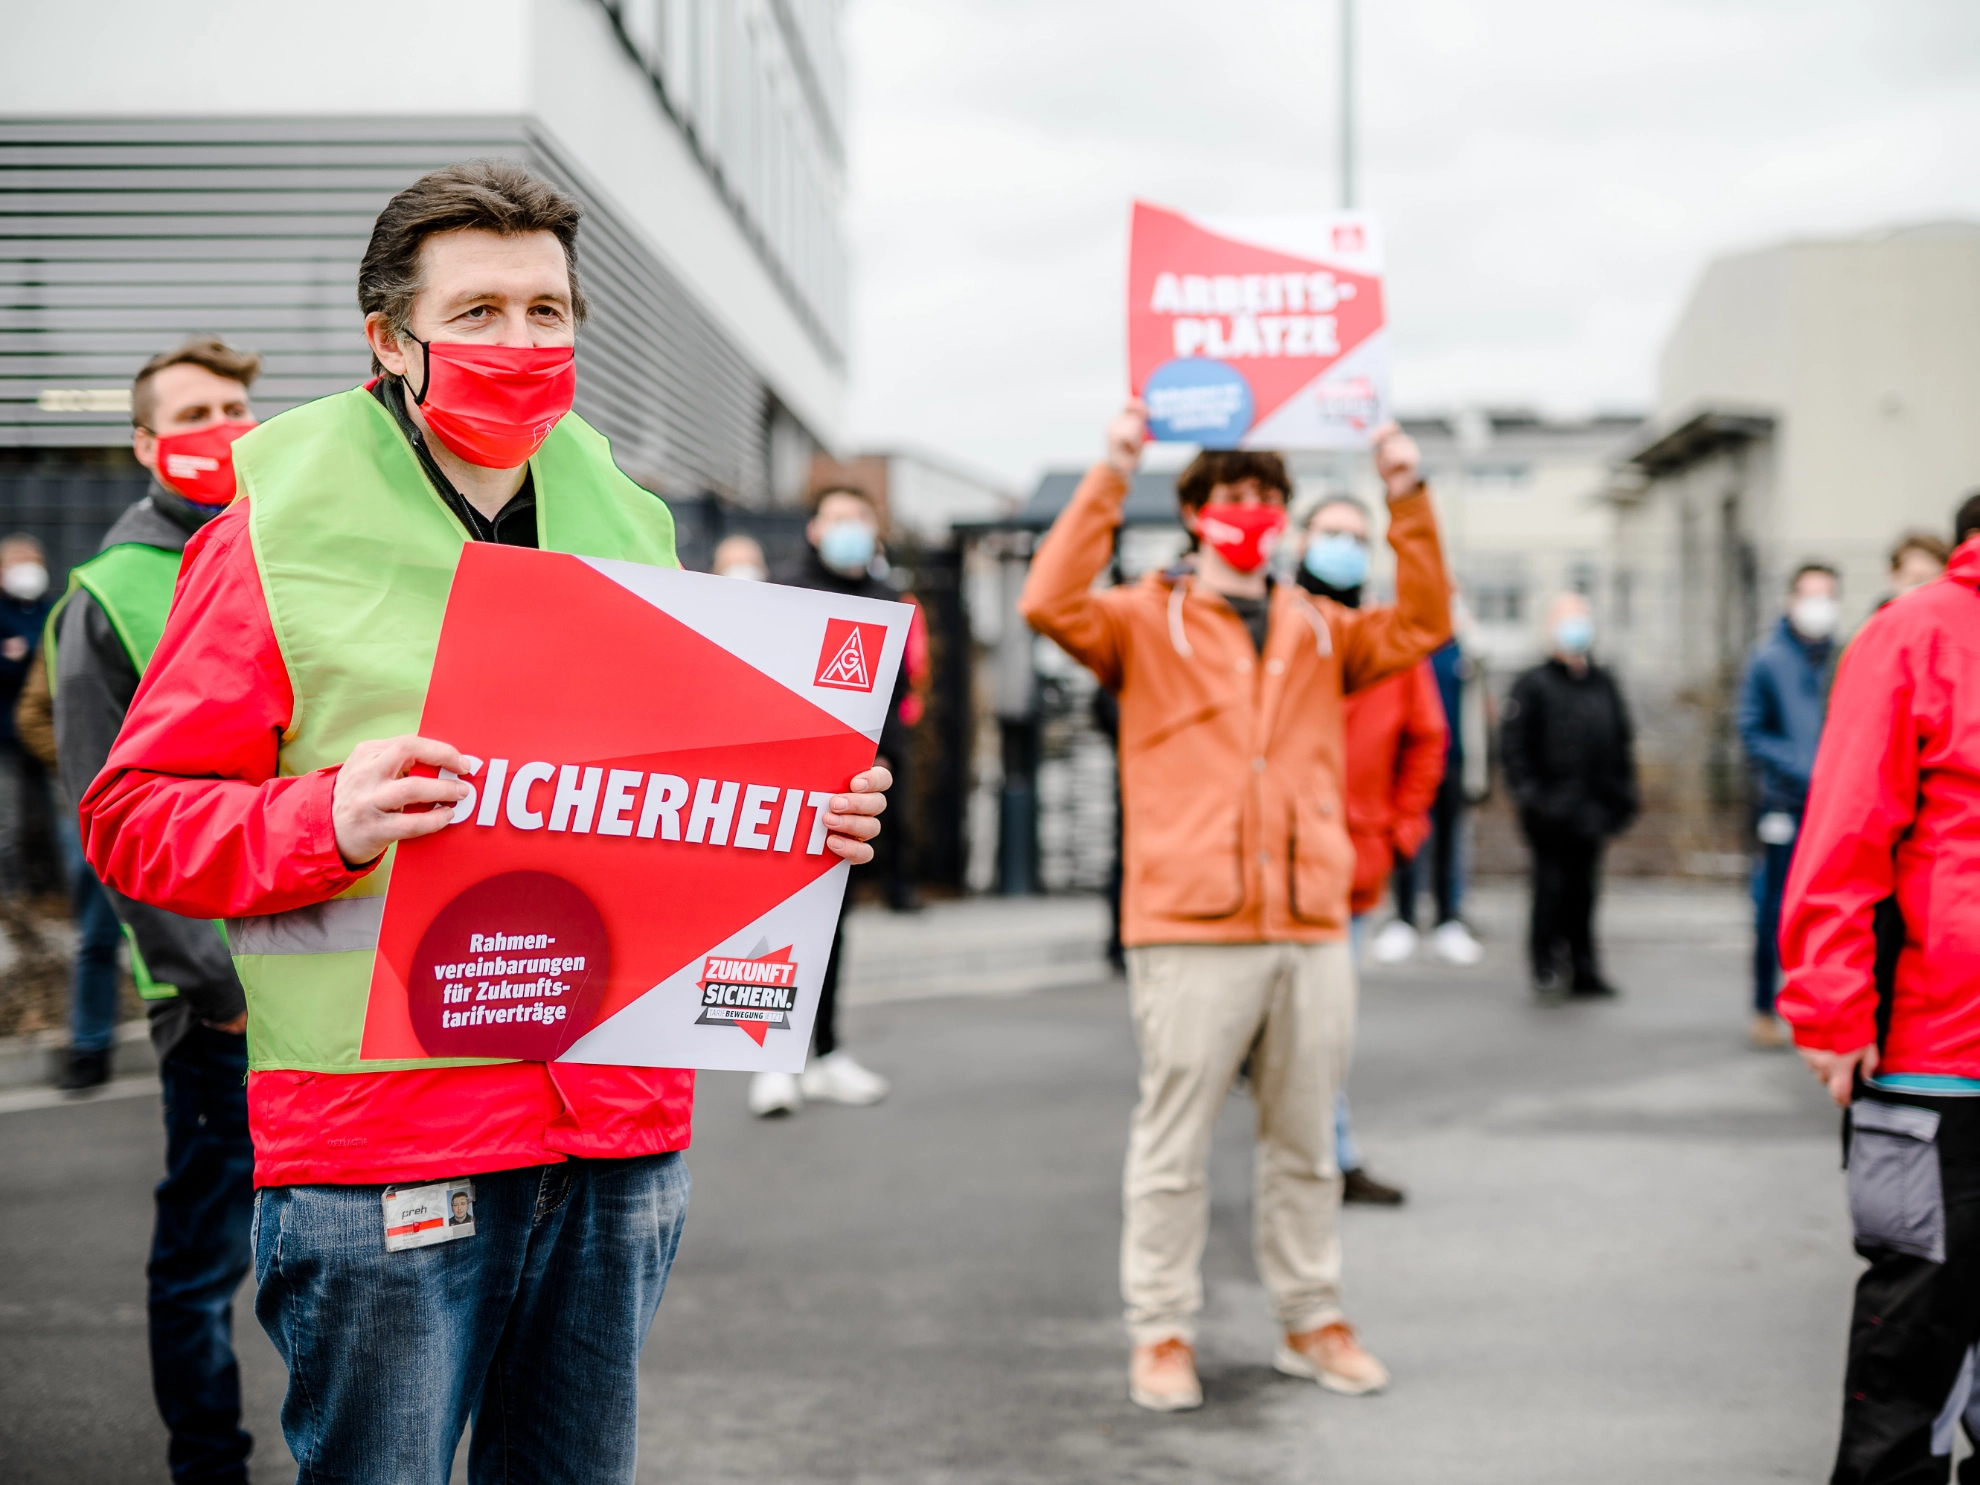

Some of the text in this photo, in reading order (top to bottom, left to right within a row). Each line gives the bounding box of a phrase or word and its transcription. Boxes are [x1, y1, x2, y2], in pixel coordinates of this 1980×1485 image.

[1151, 271, 1357, 315] ARBEITS-
[434, 754, 838, 856] SICHERHEIT
[469, 931, 556, 953] Rahmen-
[434, 956, 585, 980] vereinbarungen
[705, 959, 794, 984] ZUKUNFT
[443, 977, 571, 1004] für Zukunfts-
[704, 984, 793, 1009] SICHERN.
[442, 1002, 566, 1028] tarifverträge
[401, 1205, 428, 1220] preh
